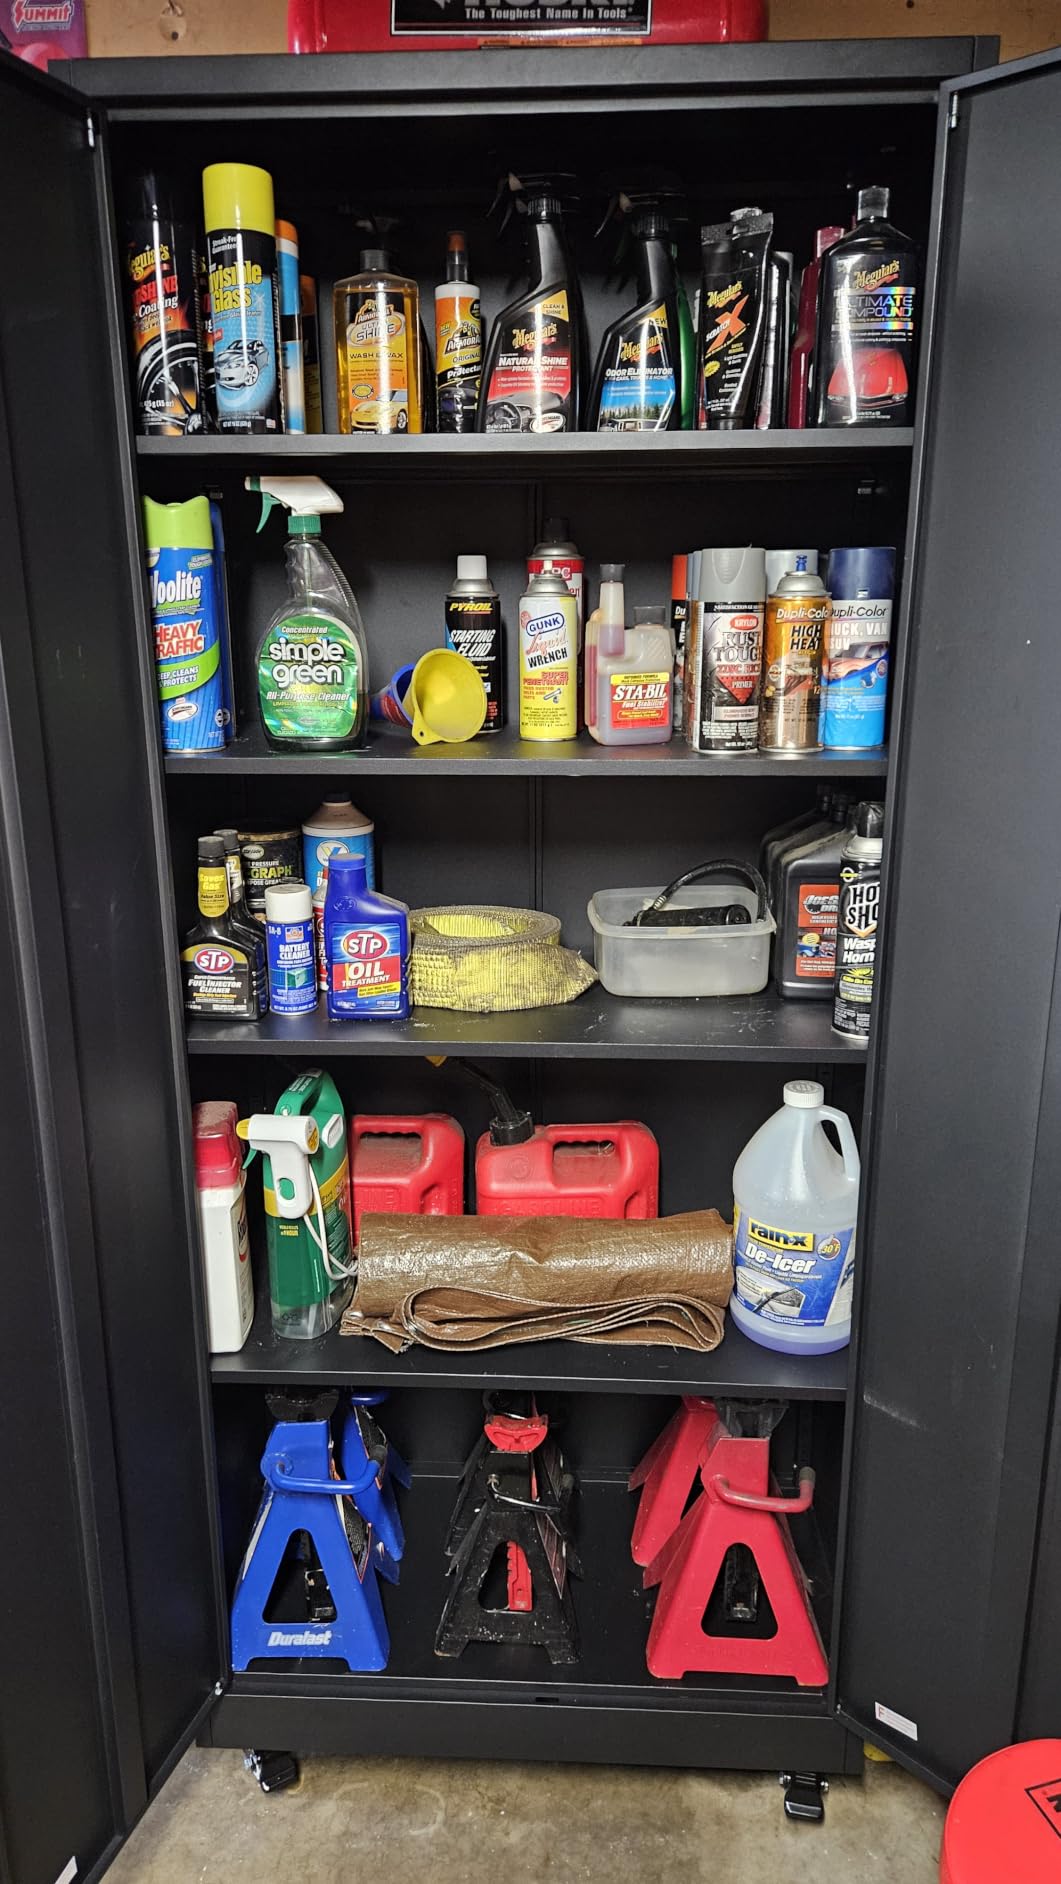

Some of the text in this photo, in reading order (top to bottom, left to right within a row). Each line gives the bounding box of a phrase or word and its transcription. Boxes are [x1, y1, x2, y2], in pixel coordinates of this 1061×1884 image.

[465, 7, 626, 20] The Toughest Name In Tools
[853, 260, 900, 292] Meguiar's
[706, 318, 731, 342] SCRATCH
[605, 368, 627, 377] ODOR
[449, 602, 494, 612] PYROIL
[776, 606, 829, 621] Dupli-Colo
[153, 621, 201, 643] HEAVY
[282, 626, 328, 635] Concentrated
[529, 616, 560, 633] GUNK
[449, 629, 496, 643] STARTING
[790, 637, 822, 650] HEAT
[154, 636, 204, 659] RAFFIC
[269, 637, 345, 665] simple
[457, 642, 493, 657] FLUID
[528, 647, 569, 669] WRENCH
[172, 665, 198, 676] CLEANS
[272, 664, 343, 689] green
[163, 674, 197, 688] PROTECTS
[316, 691, 351, 701] Cleaner
[612, 684, 667, 701] STA-BIL
[622, 701, 636, 709] Fuel
[202, 882, 222, 891] Gas
[852, 884, 879, 904] HO
[279, 942, 310, 952] BATTERY
[348, 933, 382, 955] STP
[199, 951, 228, 969] STP
[280, 950, 310, 960] CLEANER
[348, 961, 386, 980] OIL
[188, 979, 243, 989] FUEL INJECTOR
[342, 974, 390, 988] TREATMENT
[199, 986, 231, 994] CLEANER
[751, 1222, 808, 1248] rain-x
[745, 1243, 818, 1274] De-Icer
[267, 1631, 332, 1647] Duralast
